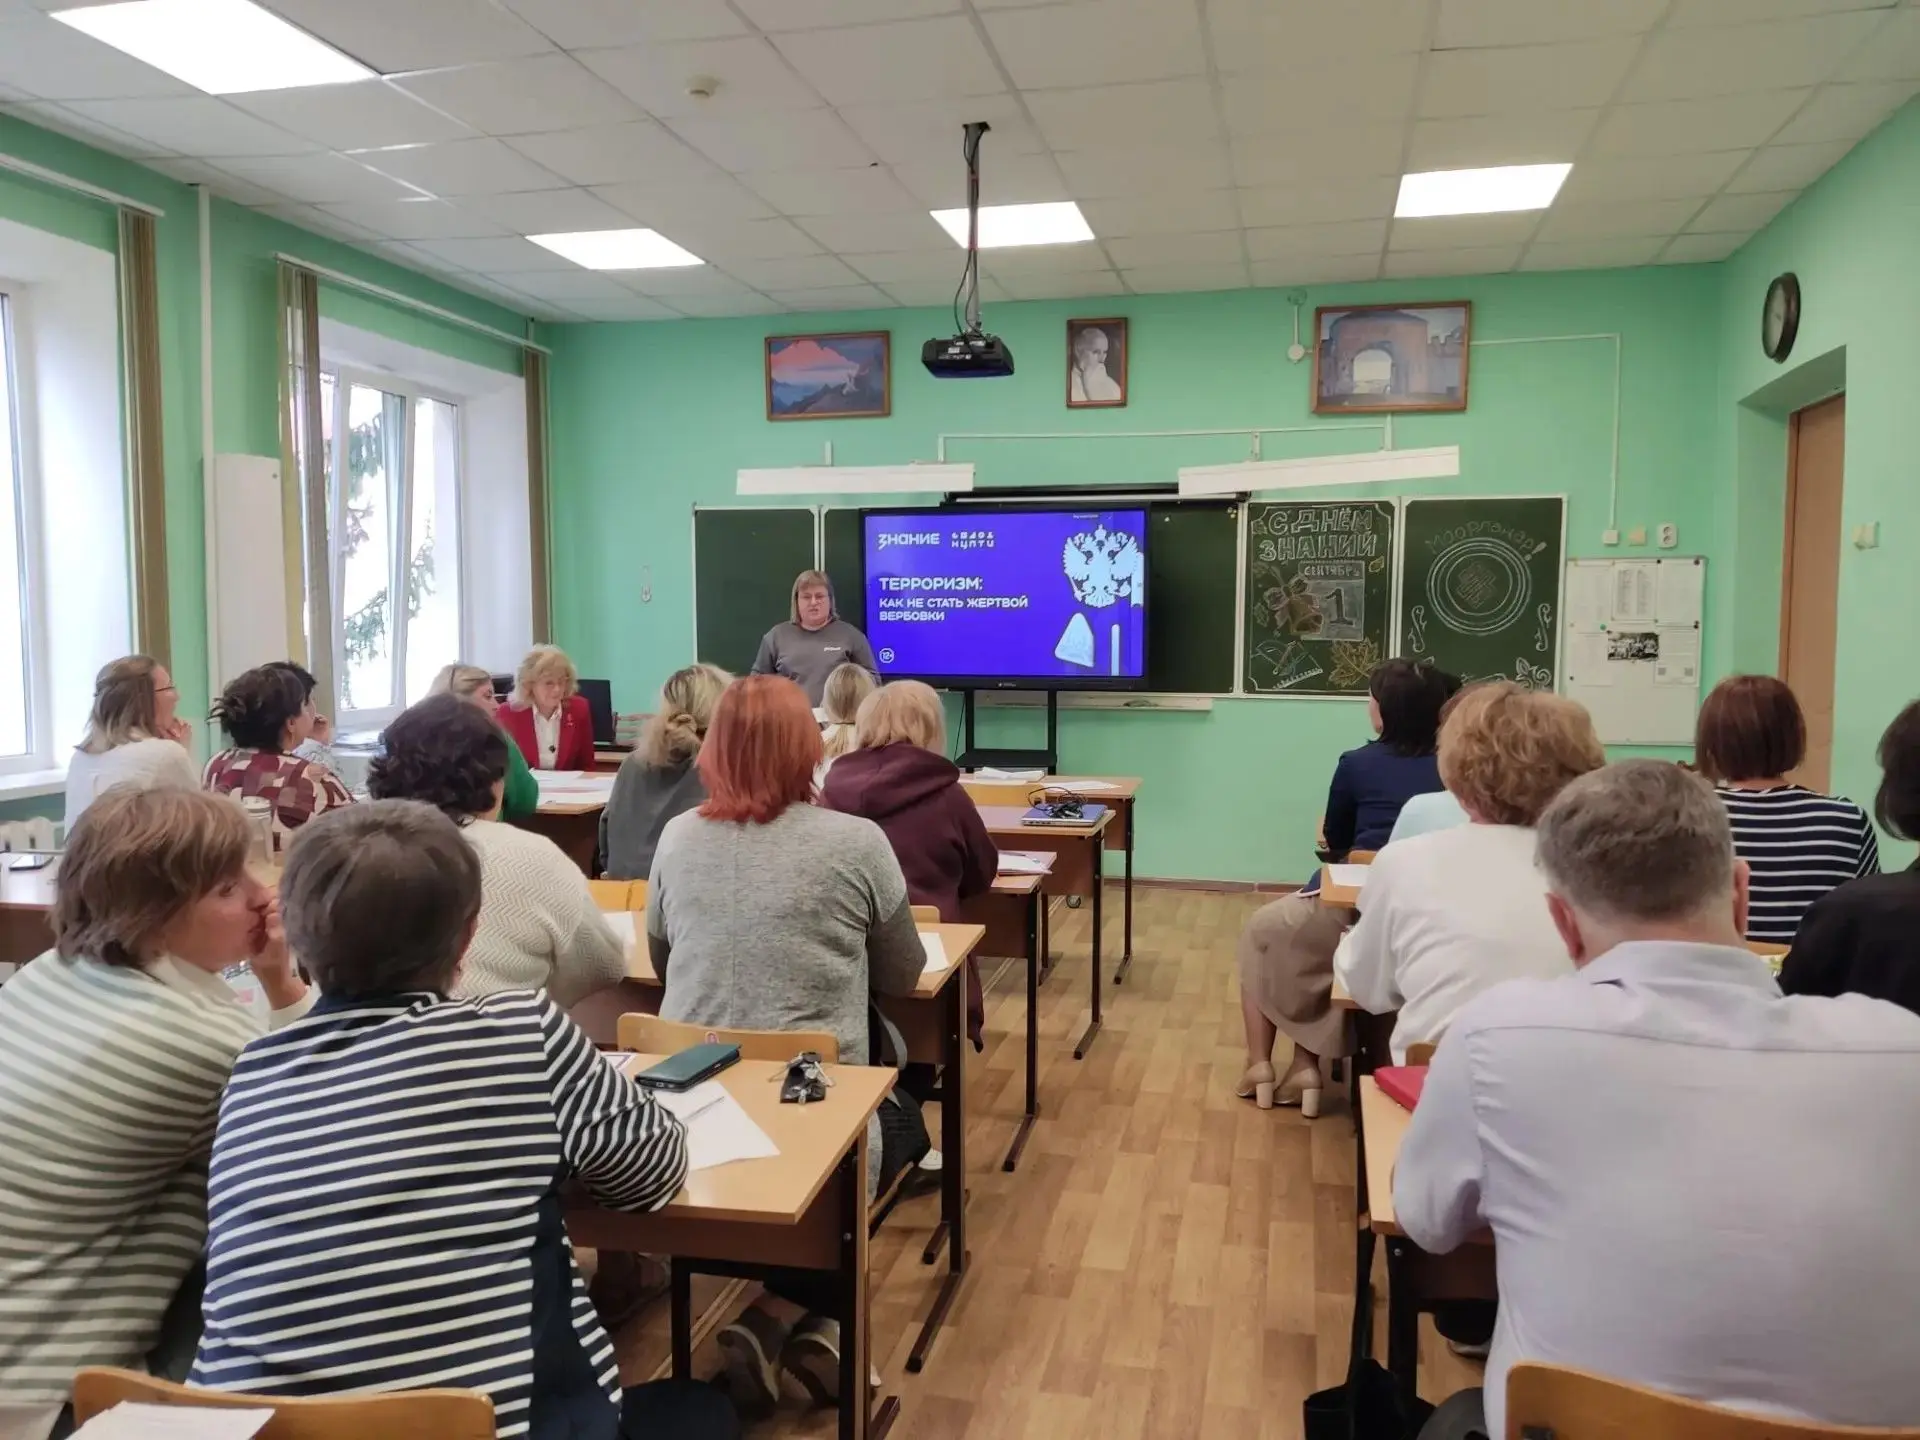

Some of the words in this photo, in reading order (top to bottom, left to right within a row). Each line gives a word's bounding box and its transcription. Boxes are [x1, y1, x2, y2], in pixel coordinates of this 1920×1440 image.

[1268, 511, 1288, 535] С
[1291, 507, 1373, 533] ДНЁМ
[1259, 531, 1377, 561] ЗНАНИЙ
[1304, 565, 1360, 577] СЕНТЯБРЬ
[879, 577, 983, 591] ТЕРРОРИЗМ:
[879, 598, 903, 608] КАК
[906, 598, 924, 608] НЕ
[927, 598, 963, 608] СТАТЬ
[966, 595, 1028, 608] ЖЕРТВОЙ
[1325, 587, 1355, 626] 1
[879, 611, 945, 621] ВЕРБОВКИ
